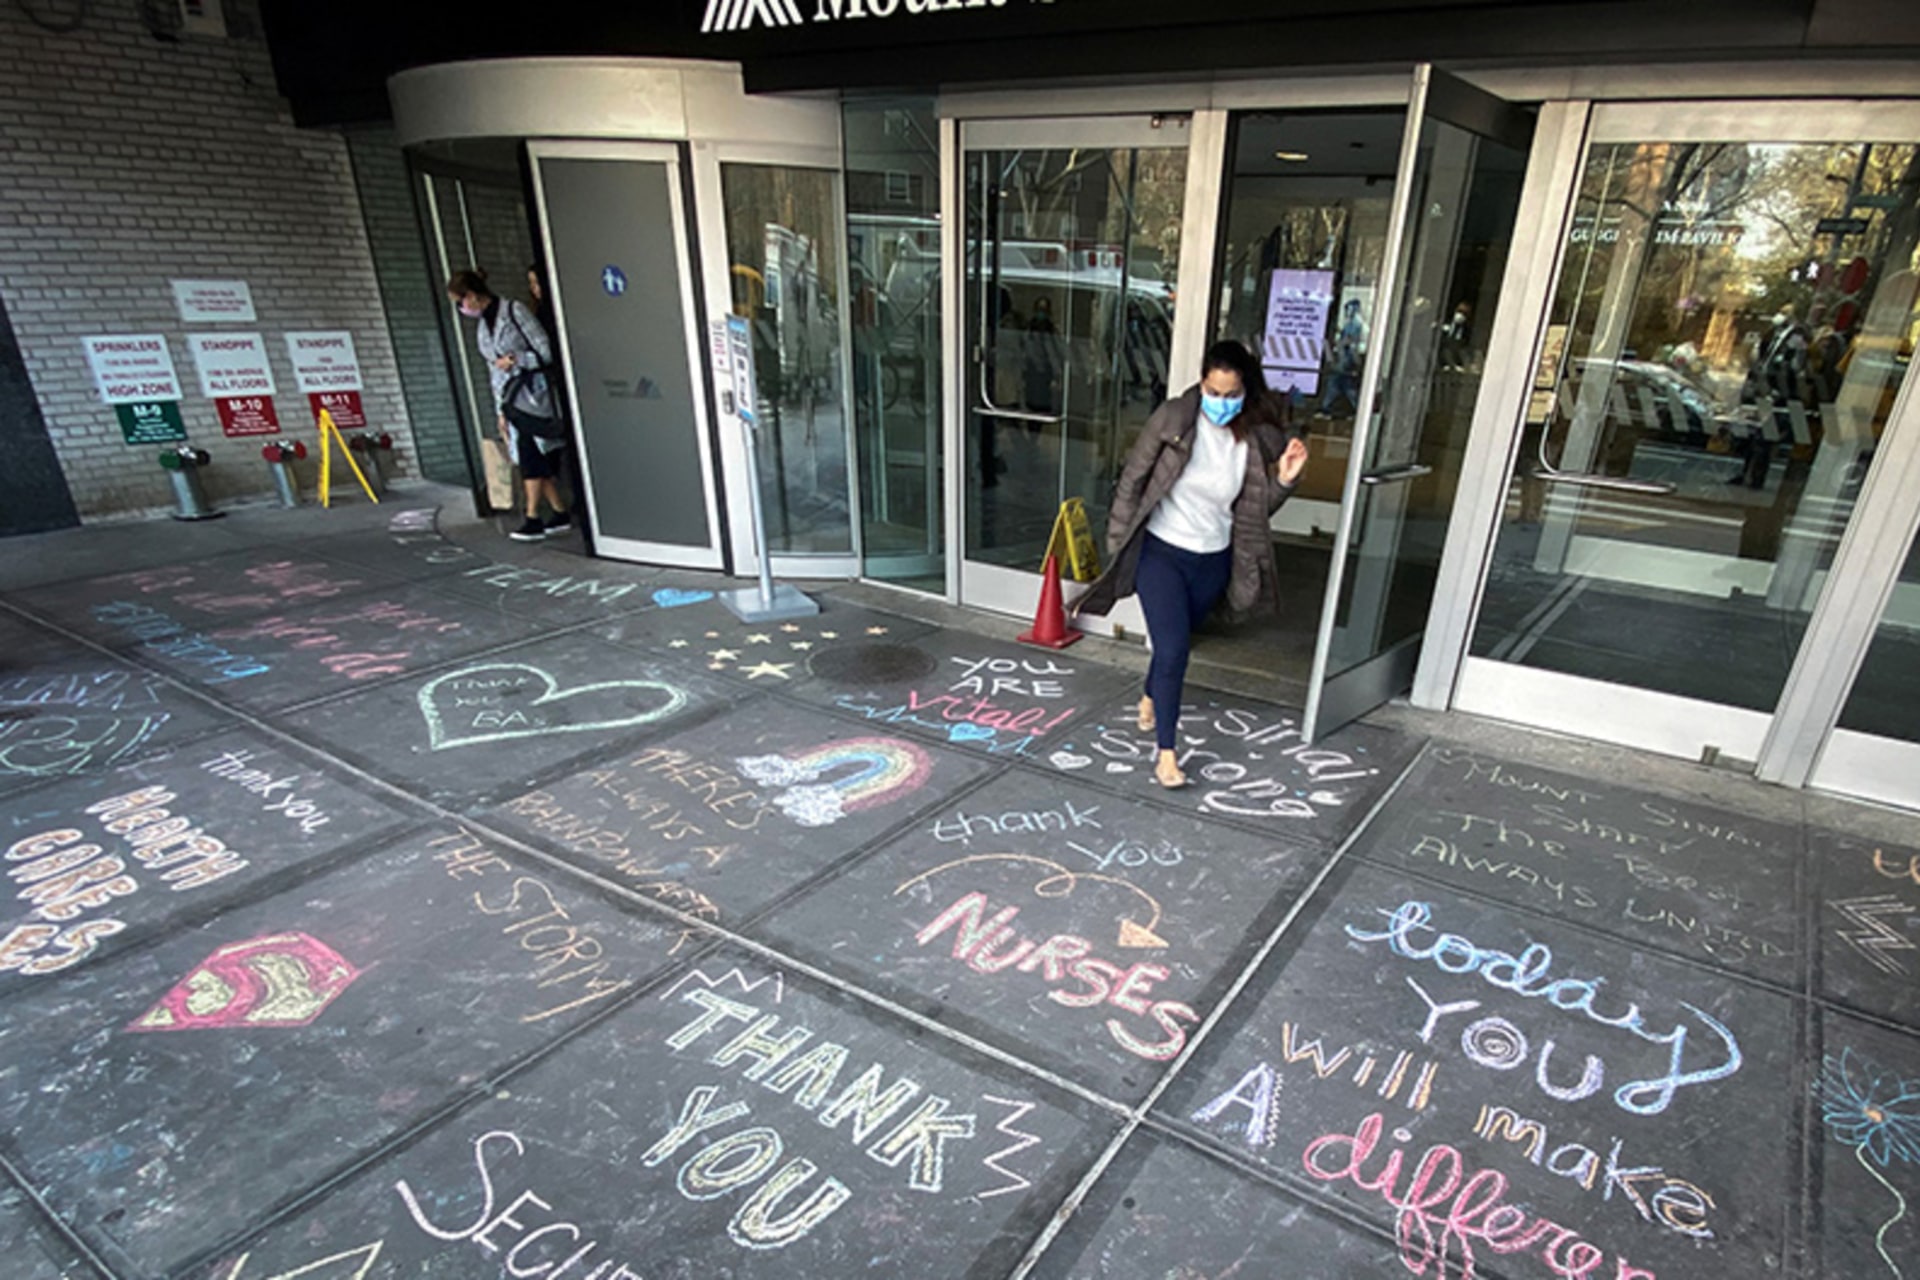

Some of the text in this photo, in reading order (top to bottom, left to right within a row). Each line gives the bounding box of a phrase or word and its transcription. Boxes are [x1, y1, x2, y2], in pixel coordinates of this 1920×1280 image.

[92, 340, 162, 353] SPRINKLERS
[201, 339, 256, 351] STANDPIPE
[296, 338, 346, 349] STANDPIPE
[106, 382, 175, 396] HIGH ZONE
[210, 378, 270, 391] ALL FLOORS
[304, 375, 358, 386] ALL FLOORS
[228, 398, 264, 411] M-10
[464, 563, 640, 603] TEAM
[952, 656, 1075, 677] YOU
[950, 676, 1065, 698] ARE
[928, 801, 1103, 844] thank
[84, 784, 251, 892] HEALTH
[1345, 900, 1743, 1116] today
[1406, 977, 1605, 1101] YOU
[664, 989, 977, 1193] THANK
[1191, 1061, 1284, 1149] A
[642, 1085, 854, 1249] YOU
